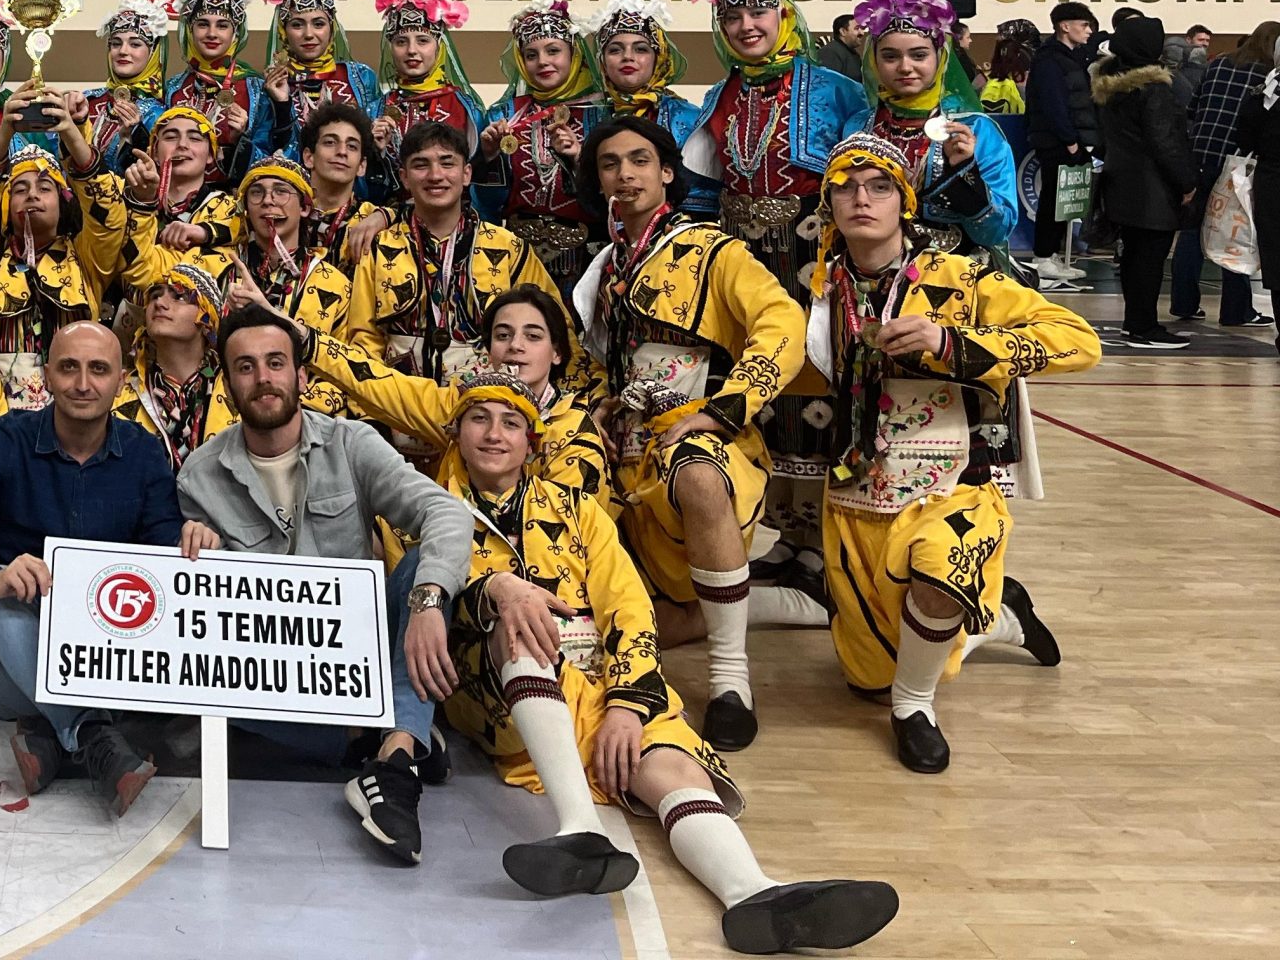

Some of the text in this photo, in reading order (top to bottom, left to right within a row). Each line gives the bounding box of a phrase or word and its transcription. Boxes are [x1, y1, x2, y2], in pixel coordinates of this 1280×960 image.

[115, 588, 143, 622] 15
[173, 571, 342, 606] ORHANGAZİ
[173, 607, 343, 649] 15 TEMMUZ
[58, 639, 372, 698] ŞEHİTLER ANADOLU LİSESİ
